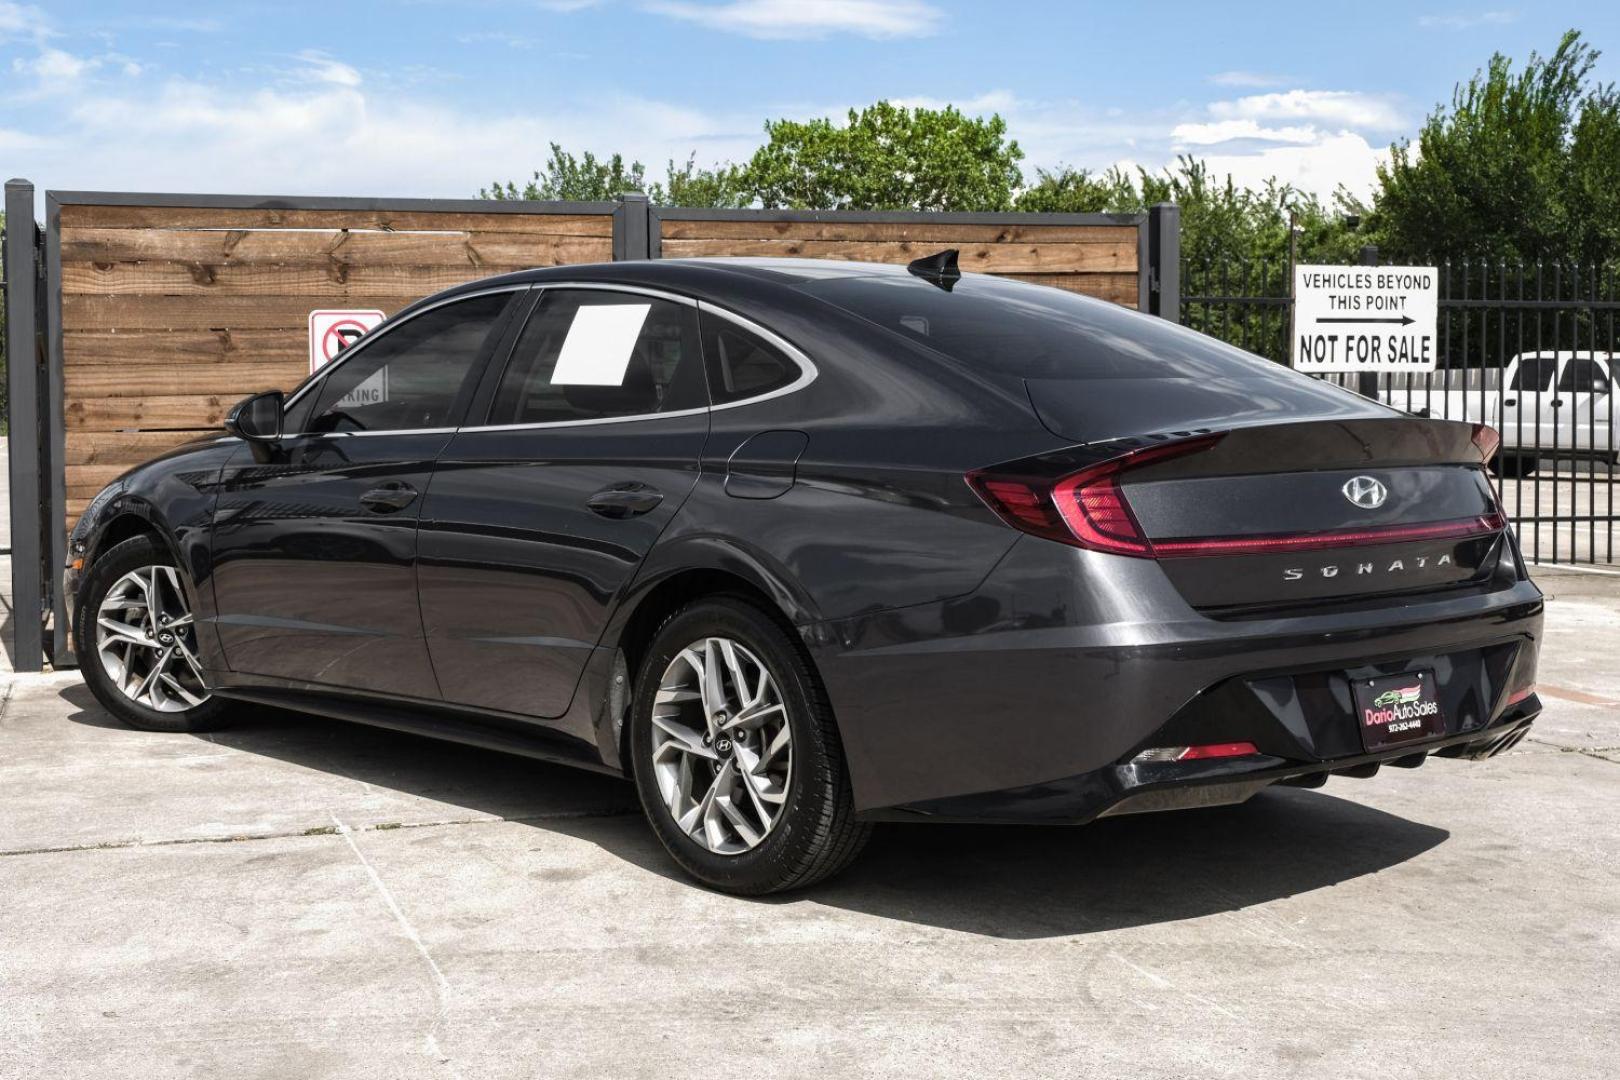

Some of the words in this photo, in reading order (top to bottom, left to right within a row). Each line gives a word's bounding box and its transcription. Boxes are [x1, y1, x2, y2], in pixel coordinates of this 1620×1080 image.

[1303, 273, 1372, 289] VEHICLES
[1377, 274, 1431, 290] BEYOND
[1329, 295, 1361, 310] THIS
[1366, 295, 1407, 310] POINT
[1300, 334, 1338, 363] NOT
[1345, 334, 1381, 363] FOR
[1387, 335, 1431, 363] SALE
[1283, 553, 1451, 580] SONATA
